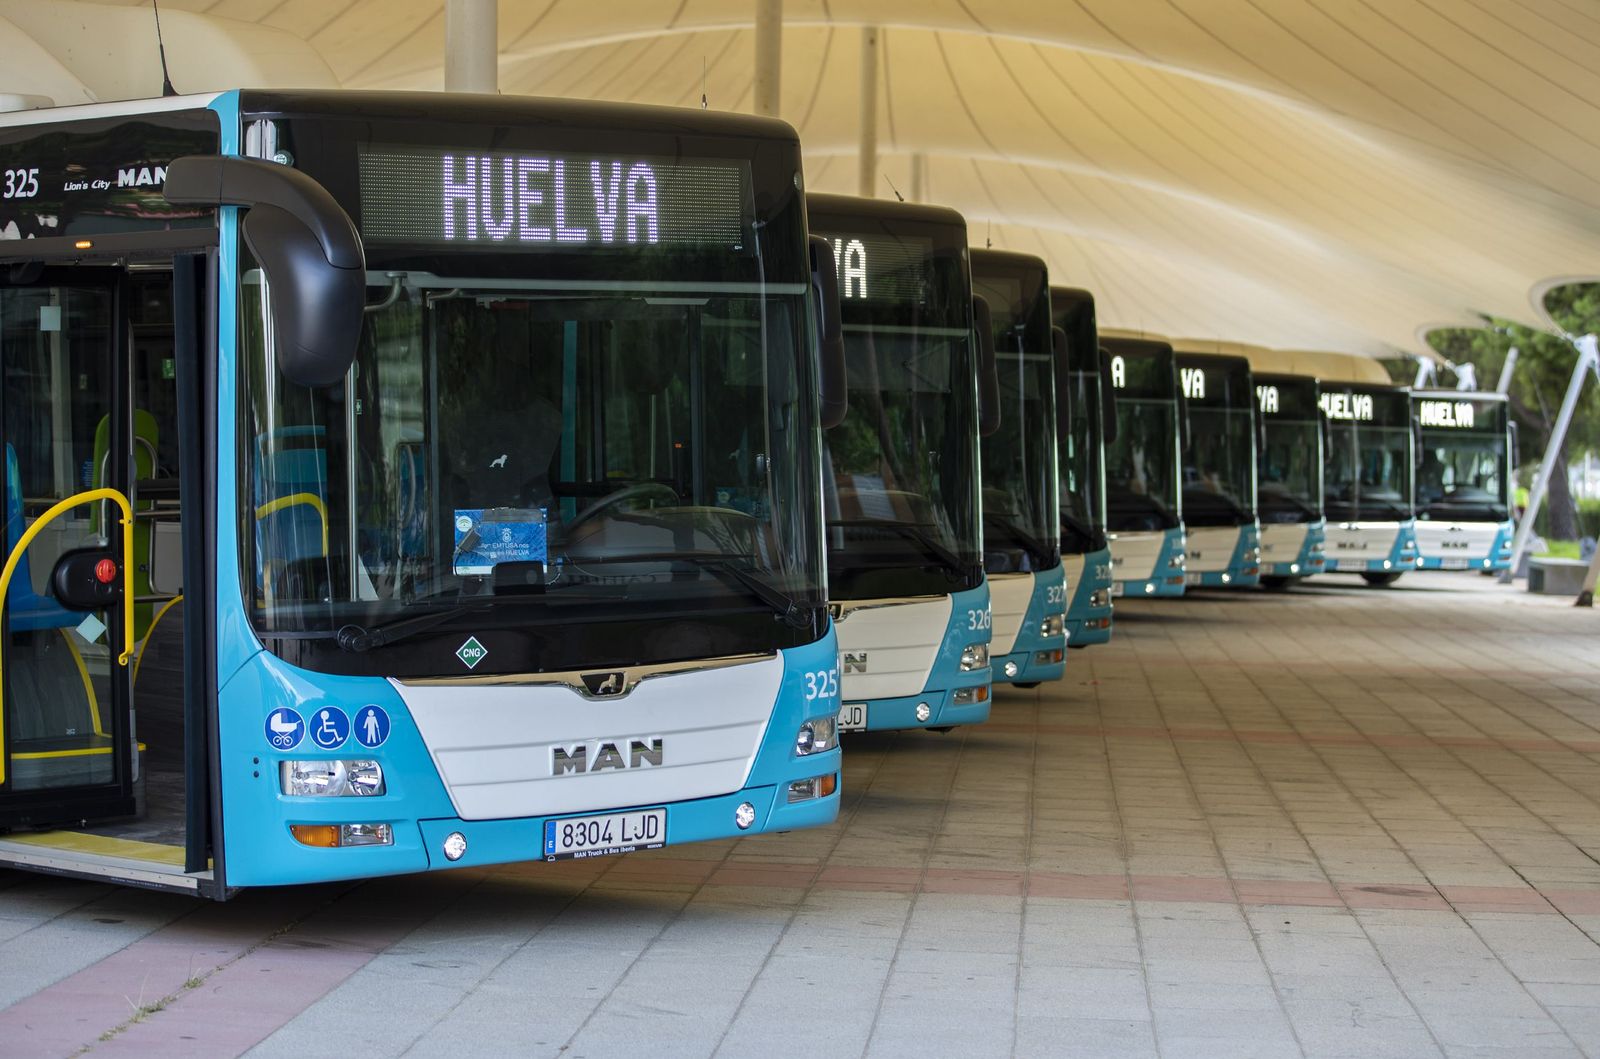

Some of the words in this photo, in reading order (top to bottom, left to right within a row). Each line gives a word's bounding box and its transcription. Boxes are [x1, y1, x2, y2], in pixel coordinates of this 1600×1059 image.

[3, 168, 39, 199] 325
[64, 181, 88, 191] Lion's
[91, 179, 111, 190] City
[117, 166, 168, 187] MAN
[444, 156, 658, 244] HUELVA
[1111, 355, 1125, 388] A
[1180, 368, 1205, 398] VA
[1420, 401, 1474, 428] HUELVA
[968, 609, 991, 631] 326
[463, 647, 481, 658] CNG
[804, 669, 837, 700] 325
[552, 738, 663, 776] MAN
[562, 819, 613, 848] 8304
[621, 814, 659, 842] LJD
